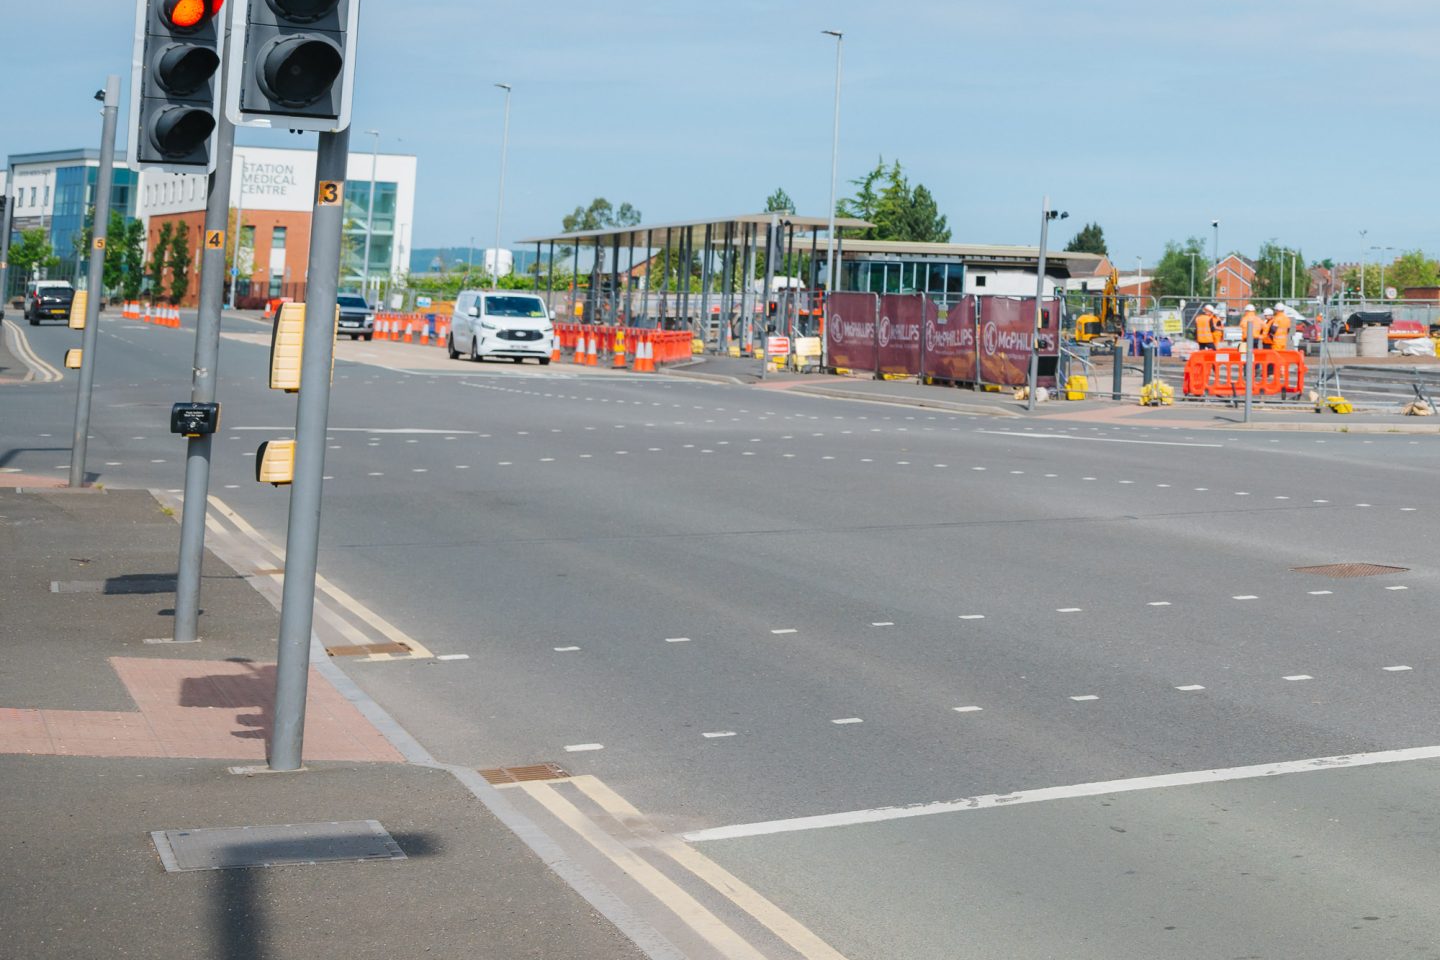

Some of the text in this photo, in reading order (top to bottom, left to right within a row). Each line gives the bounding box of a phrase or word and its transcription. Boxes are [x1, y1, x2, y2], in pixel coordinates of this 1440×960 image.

[243, 162, 294, 174] STATION
[241, 173, 297, 186] MEDICAL
[241, 183, 287, 196] CENTRE
[323, 183, 338, 203] 3
[96, 239, 103, 248] 5
[208, 232, 221, 247] 4
